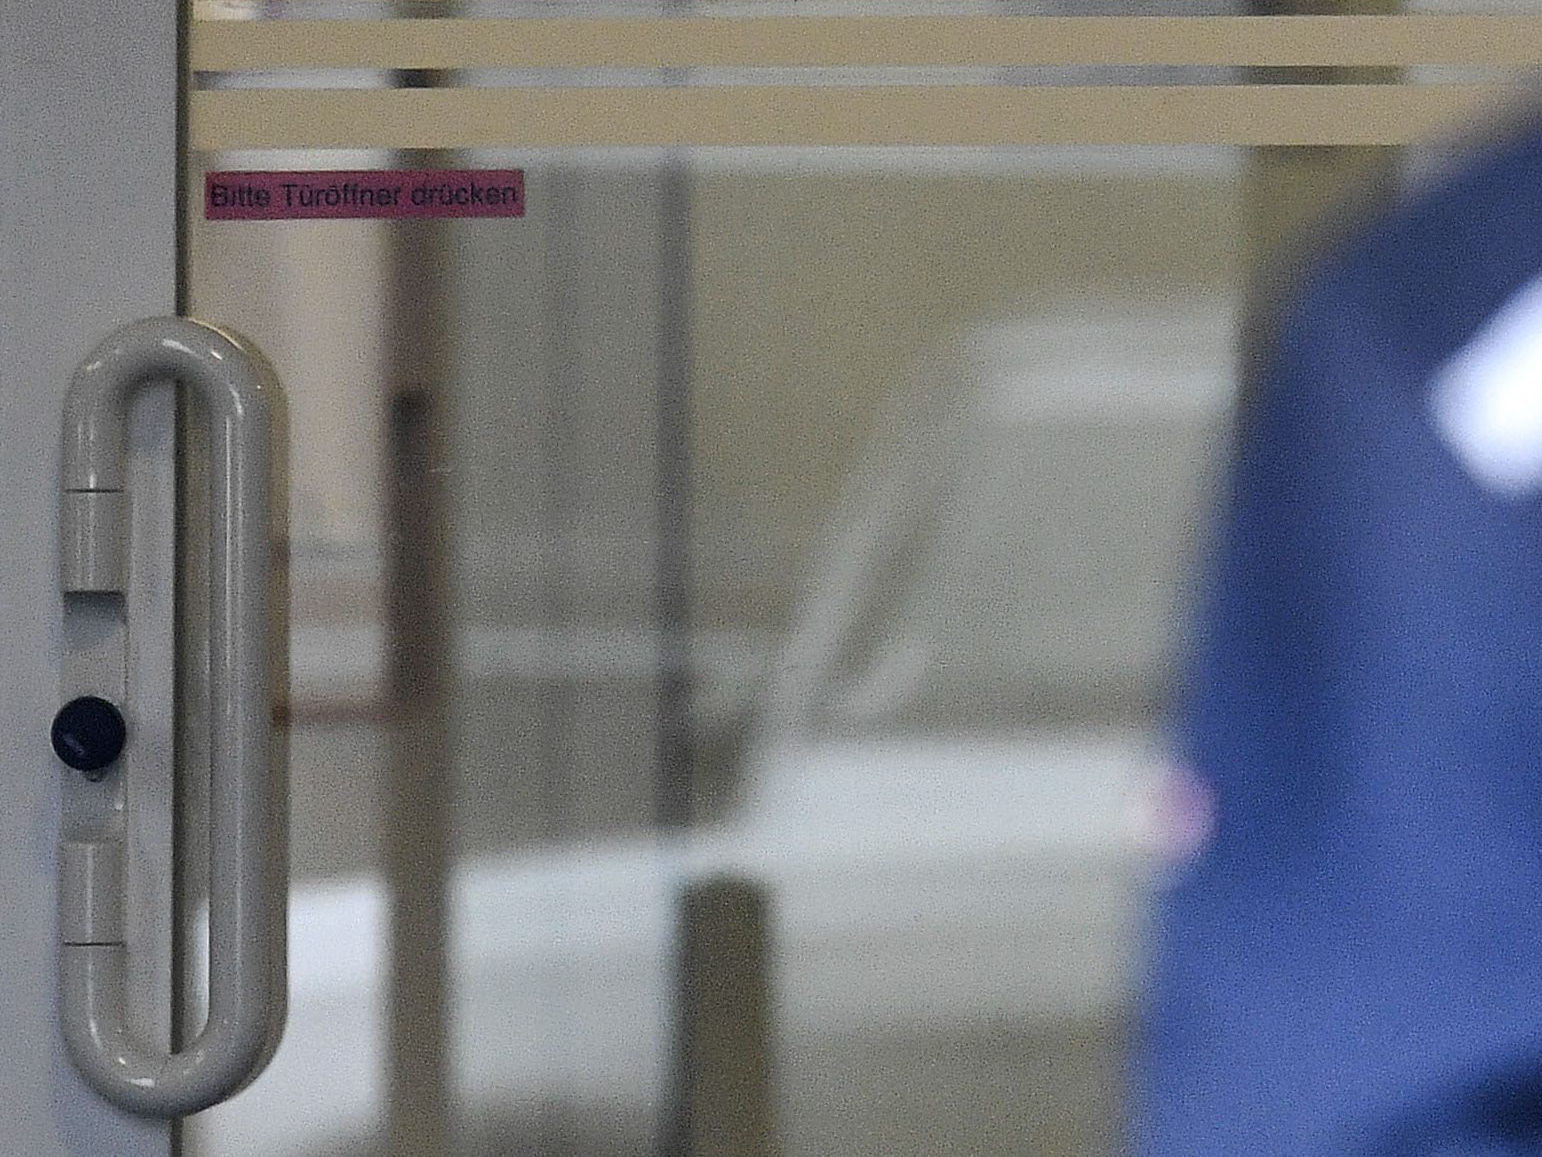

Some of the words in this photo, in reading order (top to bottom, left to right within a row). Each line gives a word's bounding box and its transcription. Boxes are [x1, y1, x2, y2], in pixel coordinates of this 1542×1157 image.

[211, 184, 271, 207] Bitte
[283, 182, 401, 207] Türöffner
[410, 181, 519, 206] drücken
